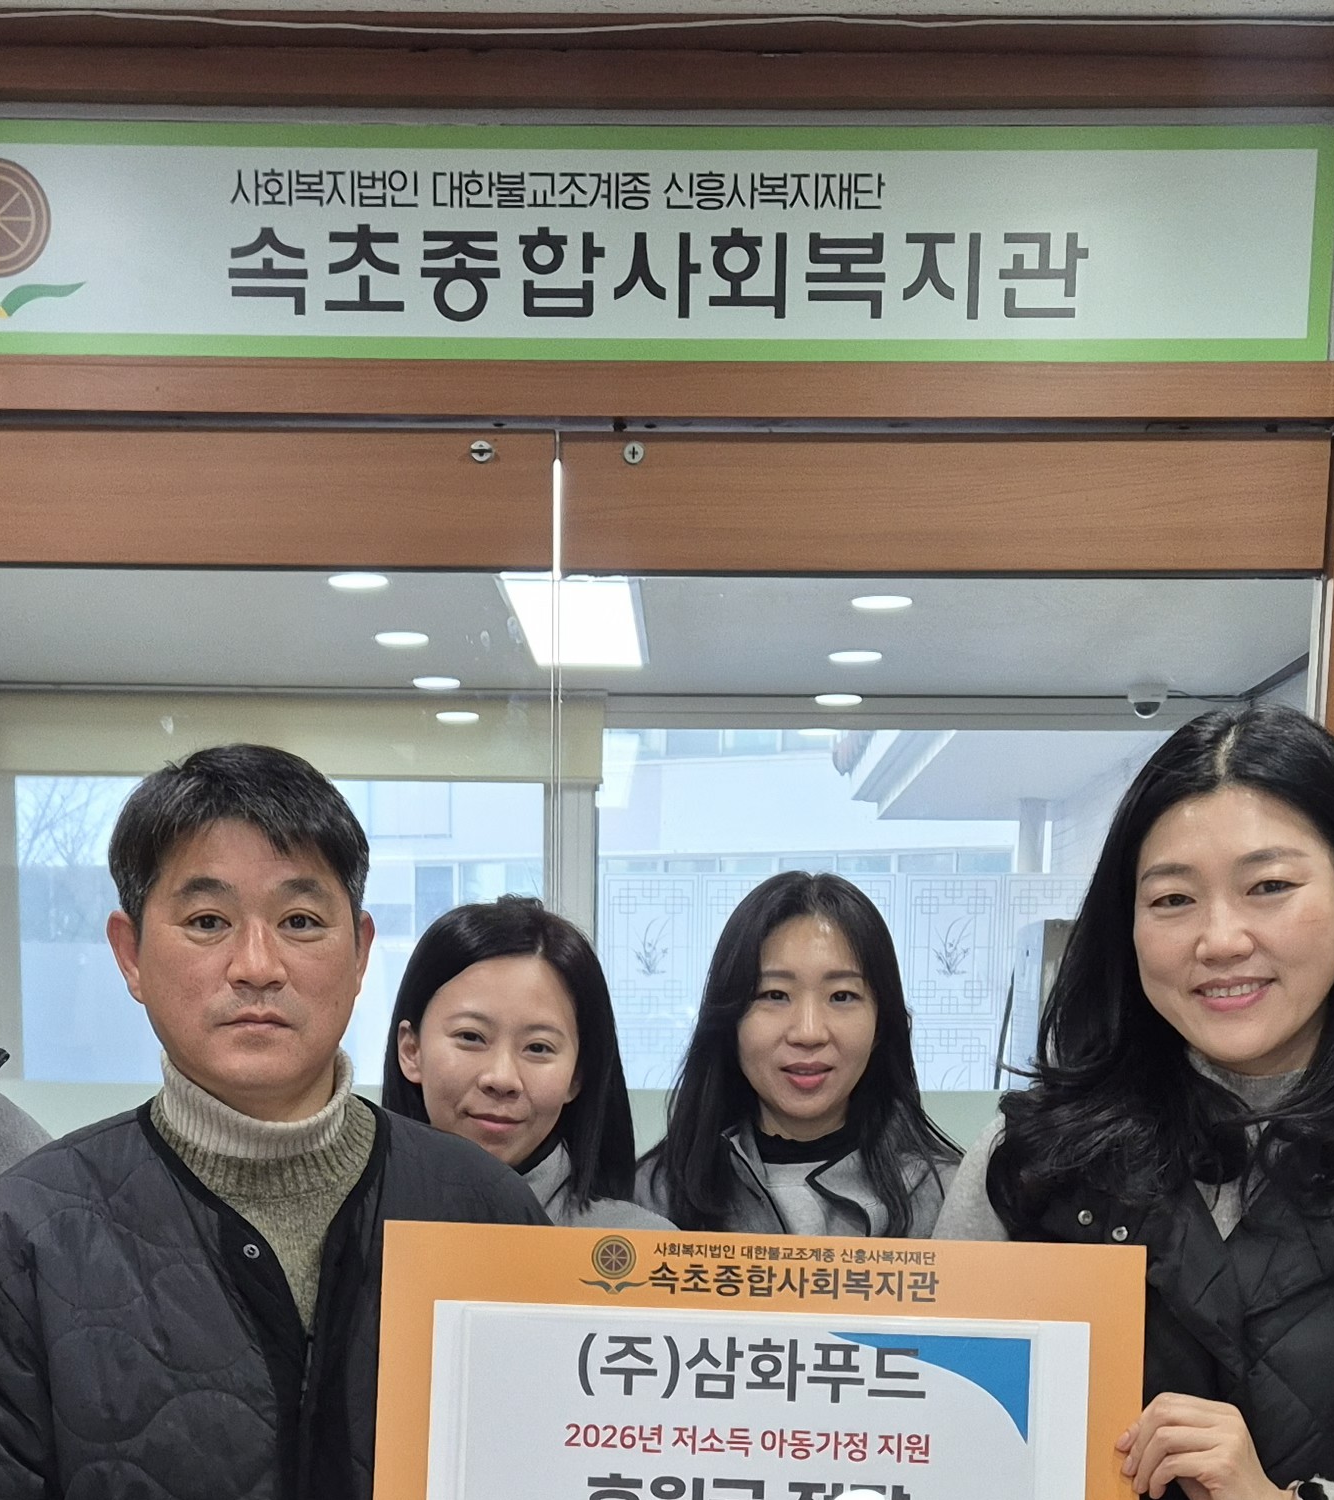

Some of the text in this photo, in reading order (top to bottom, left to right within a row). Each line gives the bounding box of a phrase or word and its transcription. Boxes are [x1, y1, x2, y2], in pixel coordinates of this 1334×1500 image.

[230, 168, 886, 211] 사회복지법인 대한불교조계종 신흥사복지재단
[228, 223, 1089, 322] 속초종합사회복지관
[653, 1242, 936, 1266] 사회복지법인 대한불교조계종 신흥사복지재단
[648, 1262, 939, 1303] 속초종합사회복지관
[578, 1332, 926, 1404] (주)삼화푸드
[564, 1423, 931, 1464] 2026년 저소득 아동가정 지원
